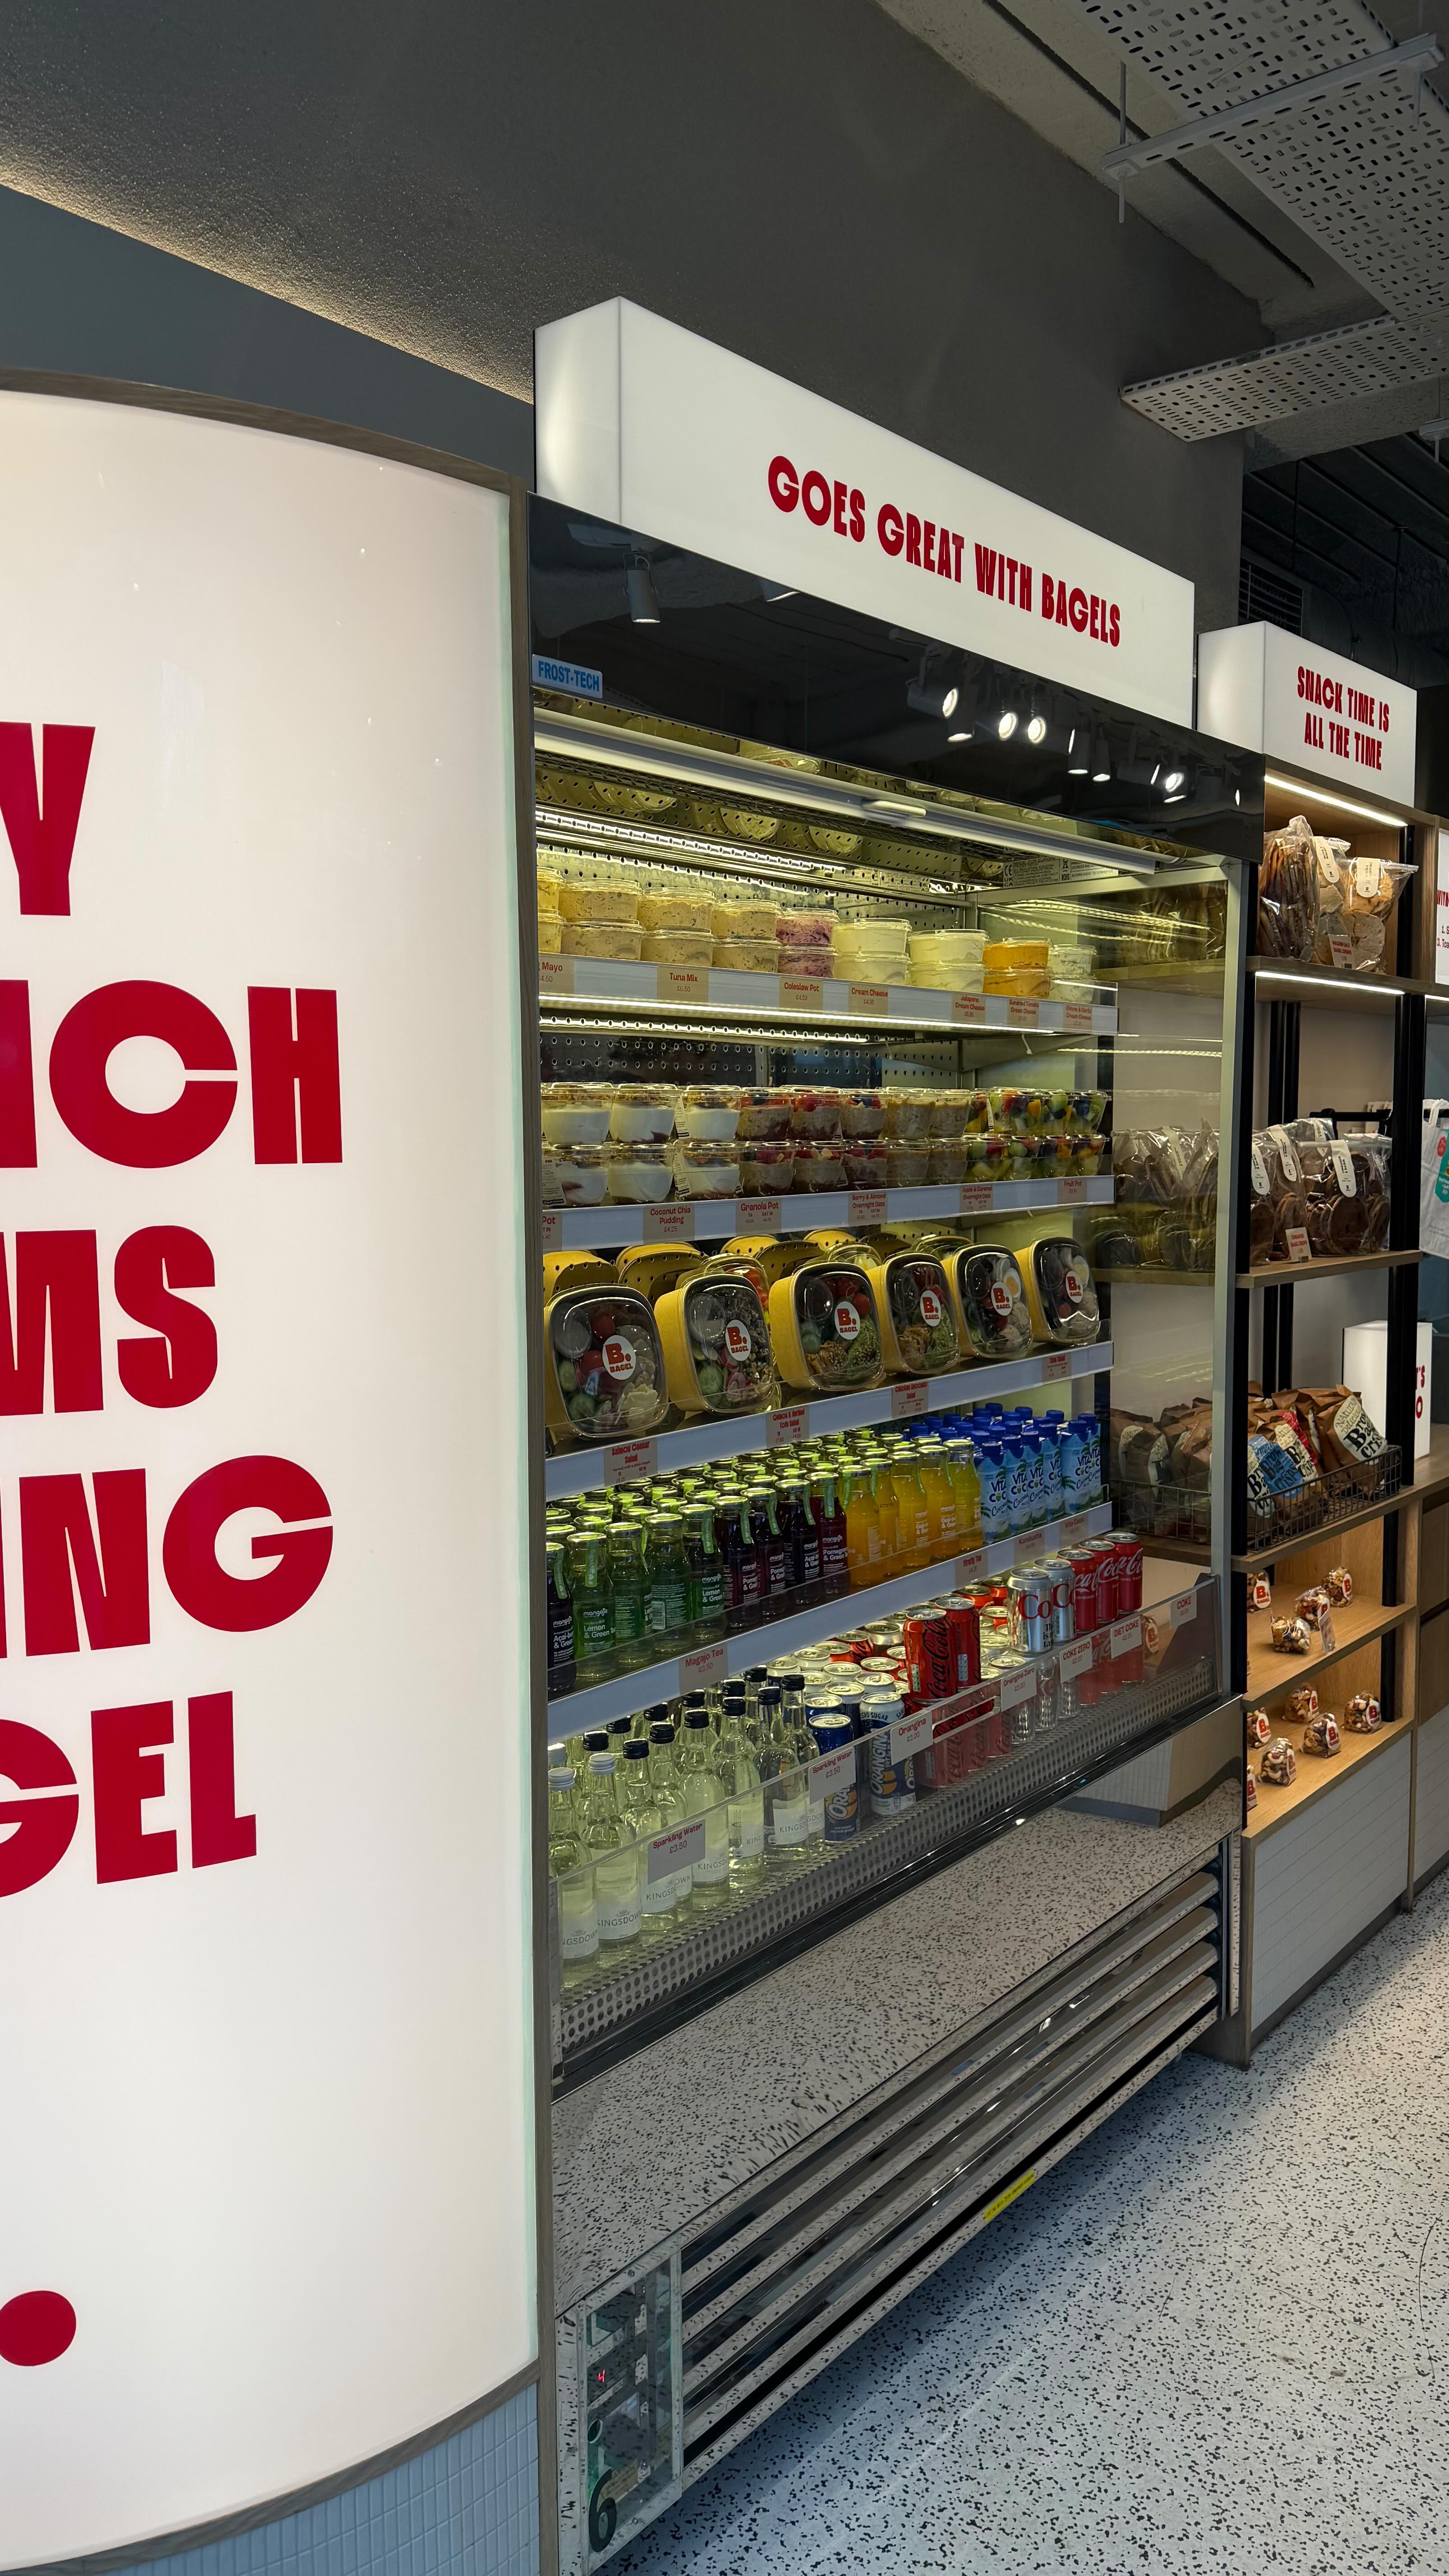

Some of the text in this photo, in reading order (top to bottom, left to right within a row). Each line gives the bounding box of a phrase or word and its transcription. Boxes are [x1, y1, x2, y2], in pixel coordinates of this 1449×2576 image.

[768, 455, 1120, 647] GOES GREAT WITH BAGELS
[538, 660, 599, 691] FROST-TECH
[1297, 666, 1389, 733] SNACK TIME IS
[1304, 712, 1382, 771] ALL THE TIME
[0, 722, 96, 917] Y
[542, 962, 563, 973] Mayo
[669, 972, 698, 982] Tuna Mix
[784, 982, 809, 991] Coleslaw
[851, 988, 888, 997] Cream Cheese
[955, 1002, 969, 1010] Cream
[0, 980, 342, 1169] CH
[651, 1208, 676, 1216] Coconut
[741, 1201, 779, 1211] Granola Pot
[659, 1216, 684, 1225] Pudding
[993, 1288, 1010, 1303] B.
[922, 1297, 939, 1313] B.
[837, 1308, 857, 1326] B.
[727, 1326, 747, 1346] B.
[605, 1343, 631, 1365] B.
[0, 1455, 333, 1659] NG
[1114, 1619, 1139, 1637] DIET COKE
[685, 1648, 724, 1667] Magajo Tea
[1063, 1641, 1090, 1660] COKE ZERO
[871, 1711, 888, 1721] SUGAR
[898, 1718, 926, 1736] Orangina
[907, 1731, 920, 1742] £3.00
[812, 1752, 852, 1774] Sparkling Water
[653, 1823, 703, 1849] Sparkling Water
[669, 1840, 687, 1854] £3.50
